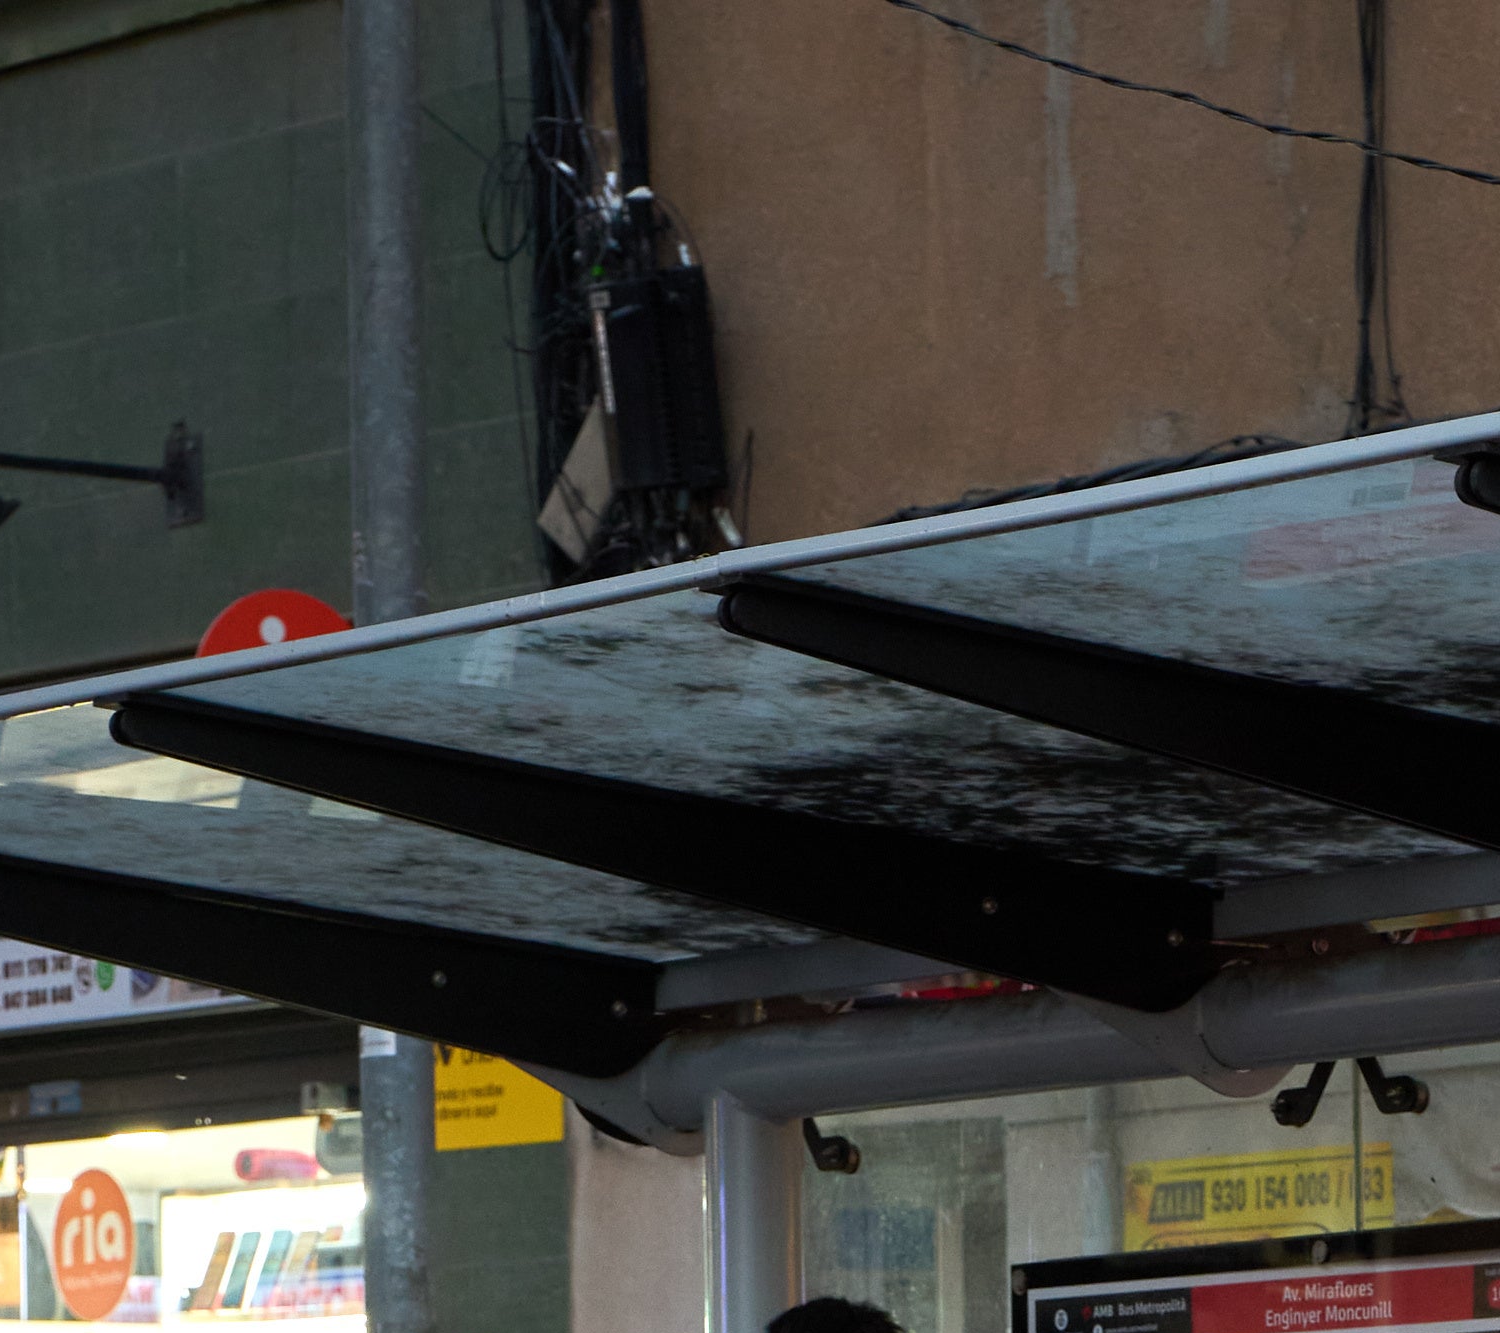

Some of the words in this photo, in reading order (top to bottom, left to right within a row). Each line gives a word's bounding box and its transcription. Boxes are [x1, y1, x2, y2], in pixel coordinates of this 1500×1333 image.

[1211, 1177, 1246, 1213] 930
[1255, 1175, 1288, 1210] 154
[62, 1187, 125, 1267] ria
[1282, 1286, 1302, 1302] Av.
[1304, 1280, 1374, 1300] Miraflores
[1265, 1306, 1321, 1330] Enginyer
[1325, 1300, 1392, 1322] Moncunill
